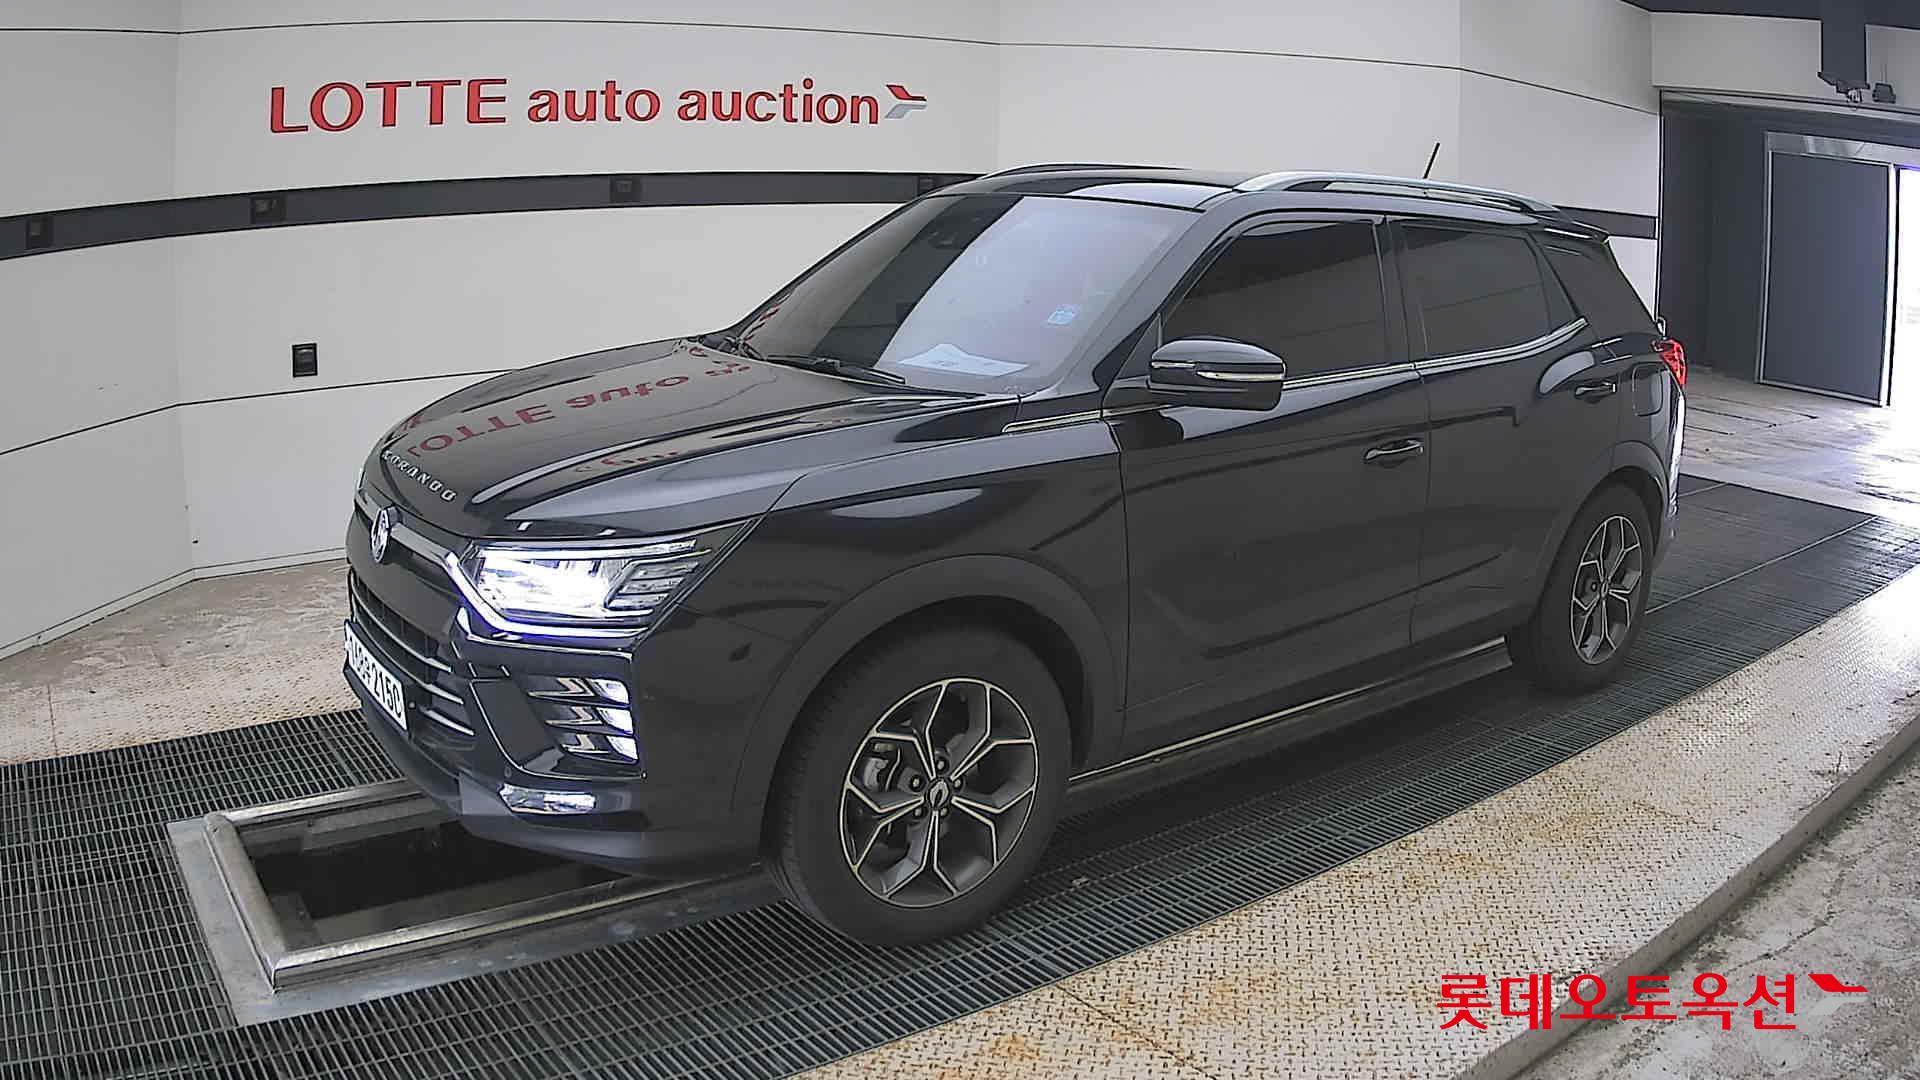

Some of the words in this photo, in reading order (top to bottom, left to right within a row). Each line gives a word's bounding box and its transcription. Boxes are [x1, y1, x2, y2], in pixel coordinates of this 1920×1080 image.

[269, 78, 508, 134] LOTTE
[526, 80, 661, 123] auto
[676, 78, 880, 125] auction
